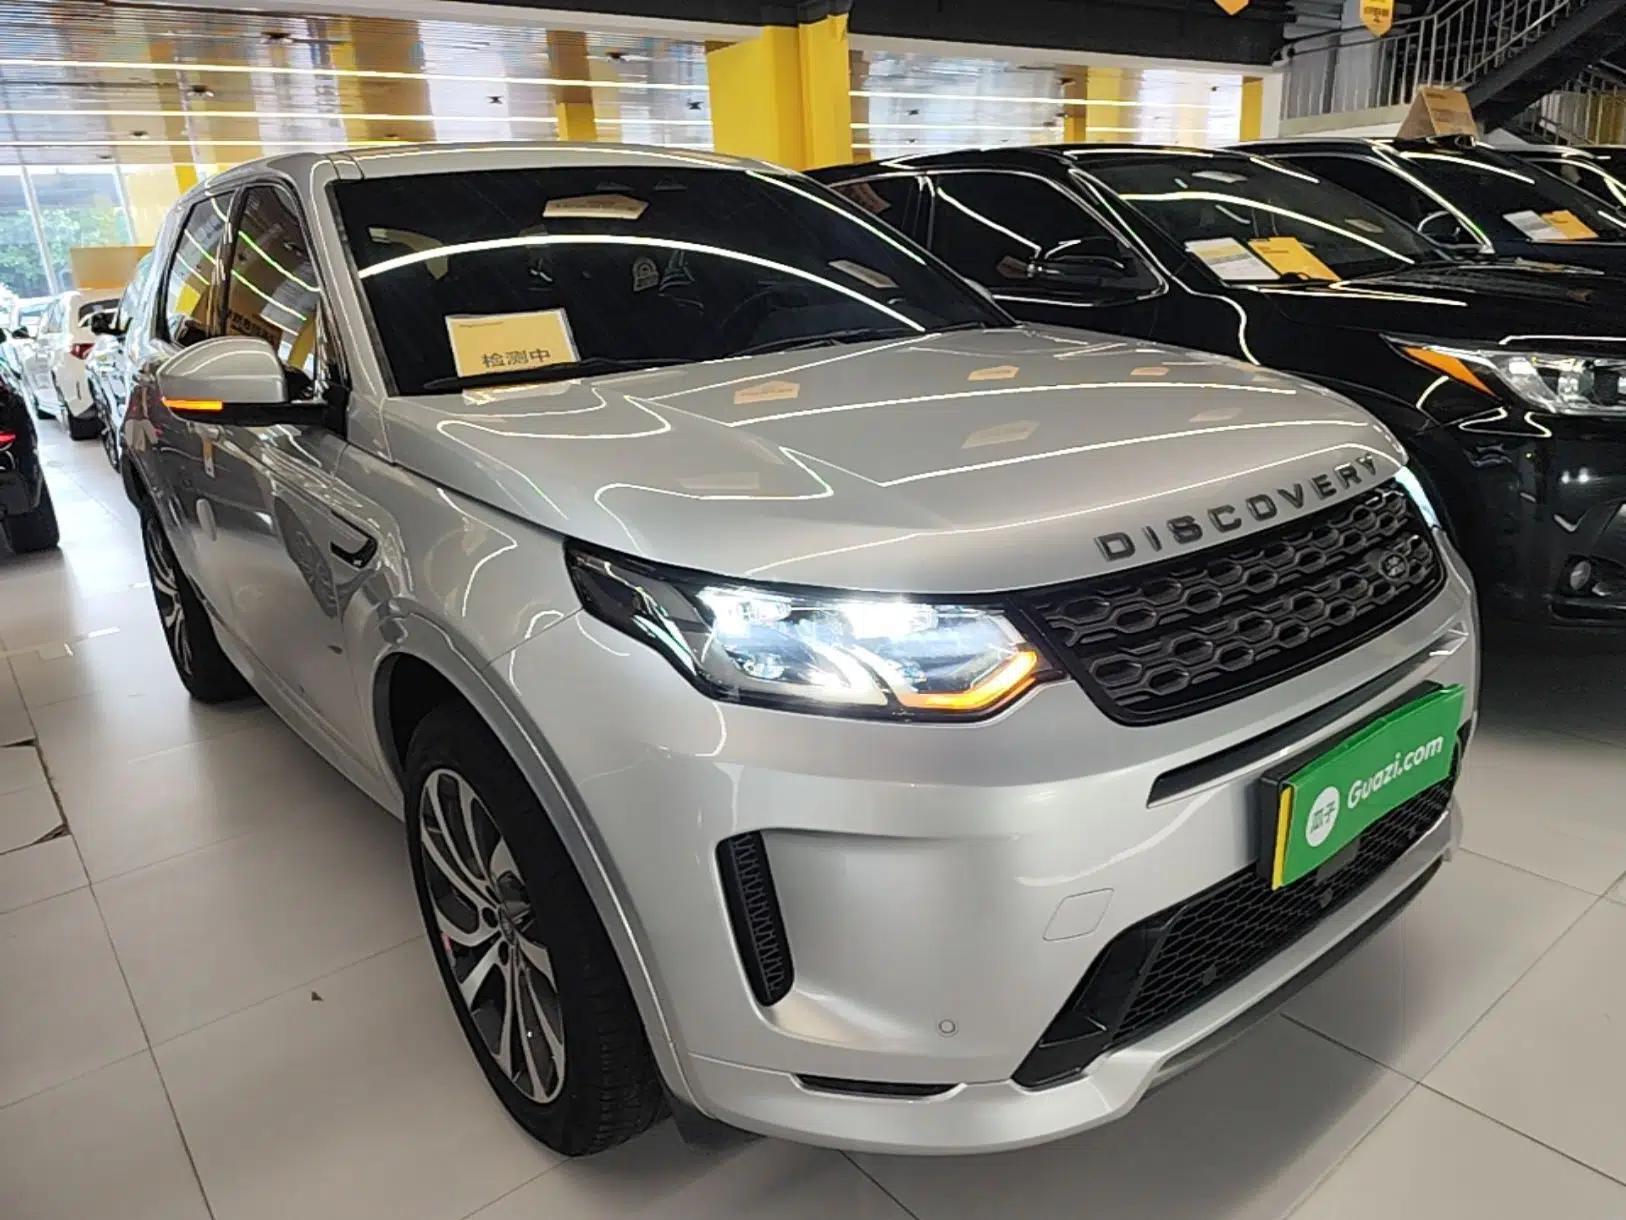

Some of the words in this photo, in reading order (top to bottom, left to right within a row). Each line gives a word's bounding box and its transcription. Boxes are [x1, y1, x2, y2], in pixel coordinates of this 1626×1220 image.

[481, 348, 551, 368] 检测中
[1094, 453, 1378, 562] DISCOVERY
[1347, 735, 1444, 810] Guazi.com
